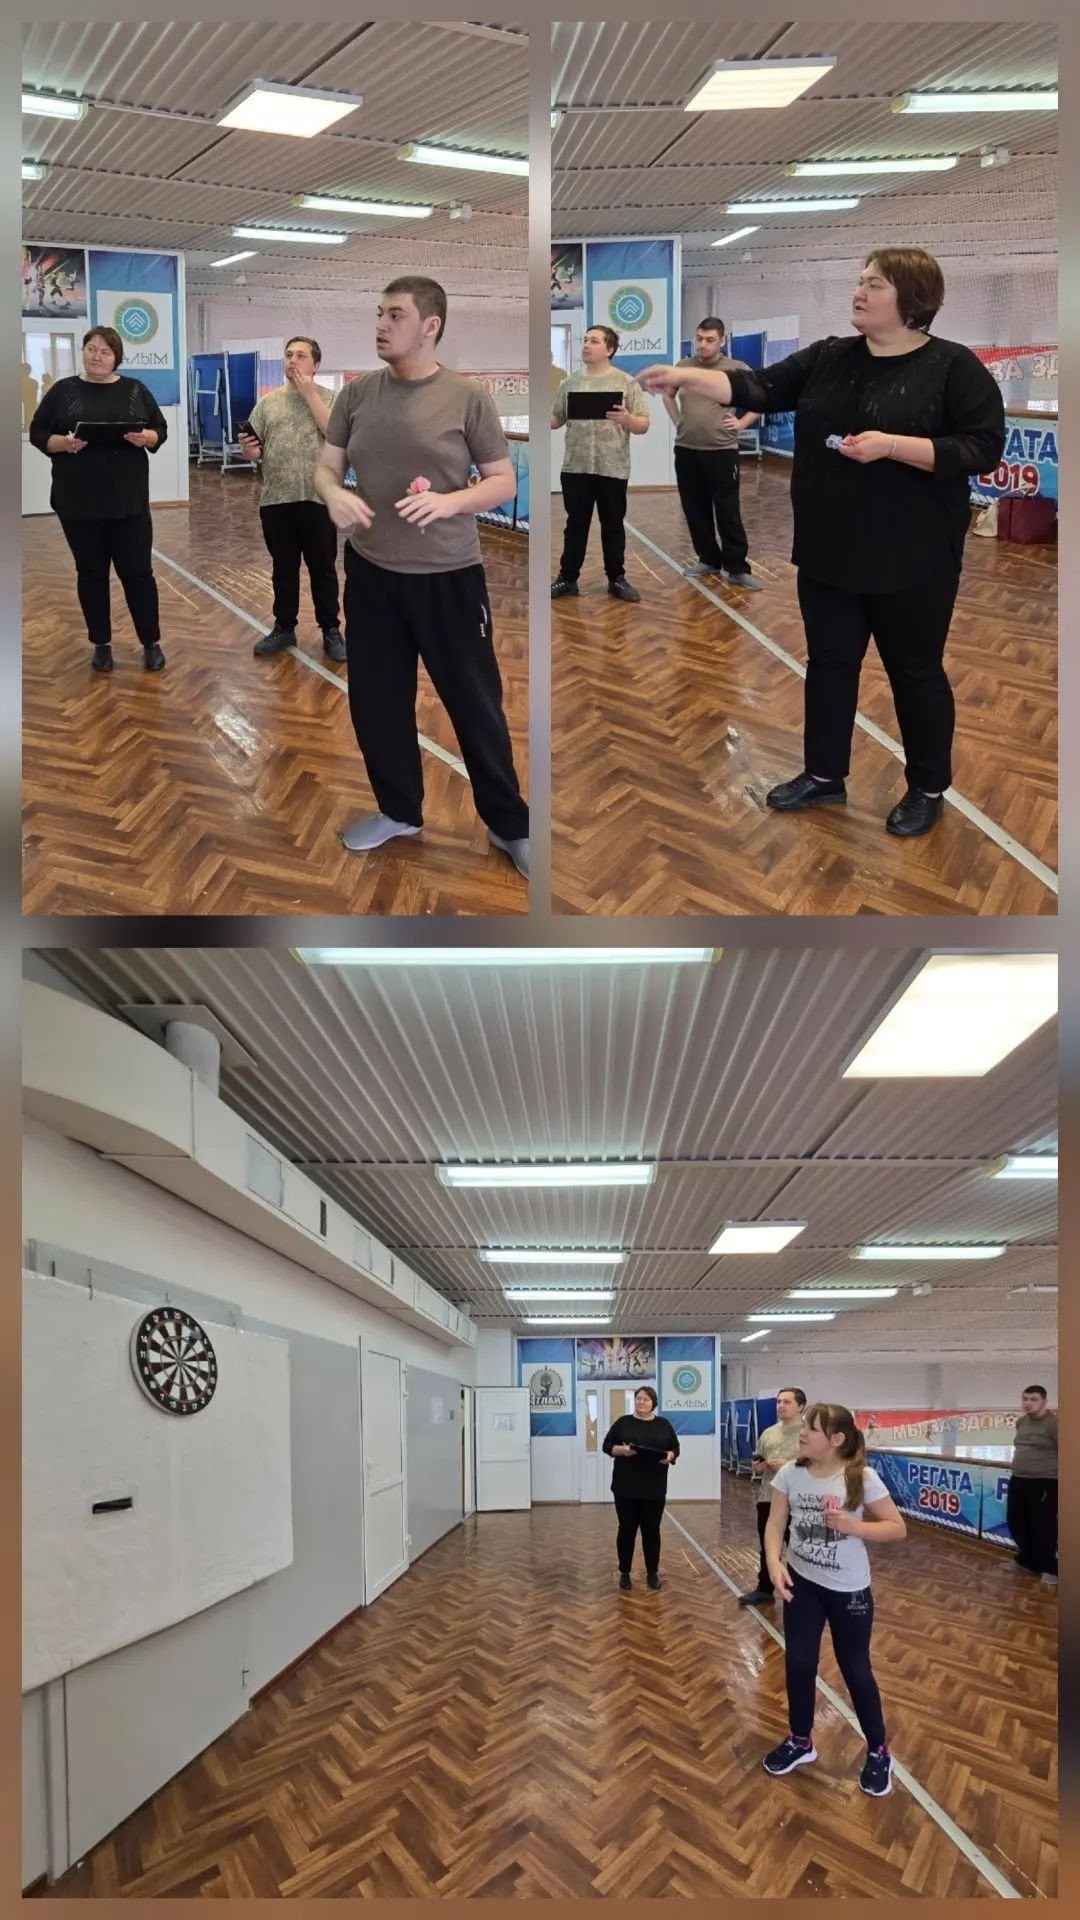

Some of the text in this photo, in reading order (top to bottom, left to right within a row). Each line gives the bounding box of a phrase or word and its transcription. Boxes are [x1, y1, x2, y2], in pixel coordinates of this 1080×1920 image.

[618, 337, 663, 351] ЛЫМ
[123, 352, 168, 365] АЛЫМ
[1032, 354, 1058, 380] ЗД
[1005, 427, 1058, 464] АТА
[959, 1413, 1019, 1431] ЗДОРО
[908, 1463, 974, 1495] РЕГАТА
[797, 1493, 838, 1504] NEV
[919, 1487, 960, 1515] 2019
